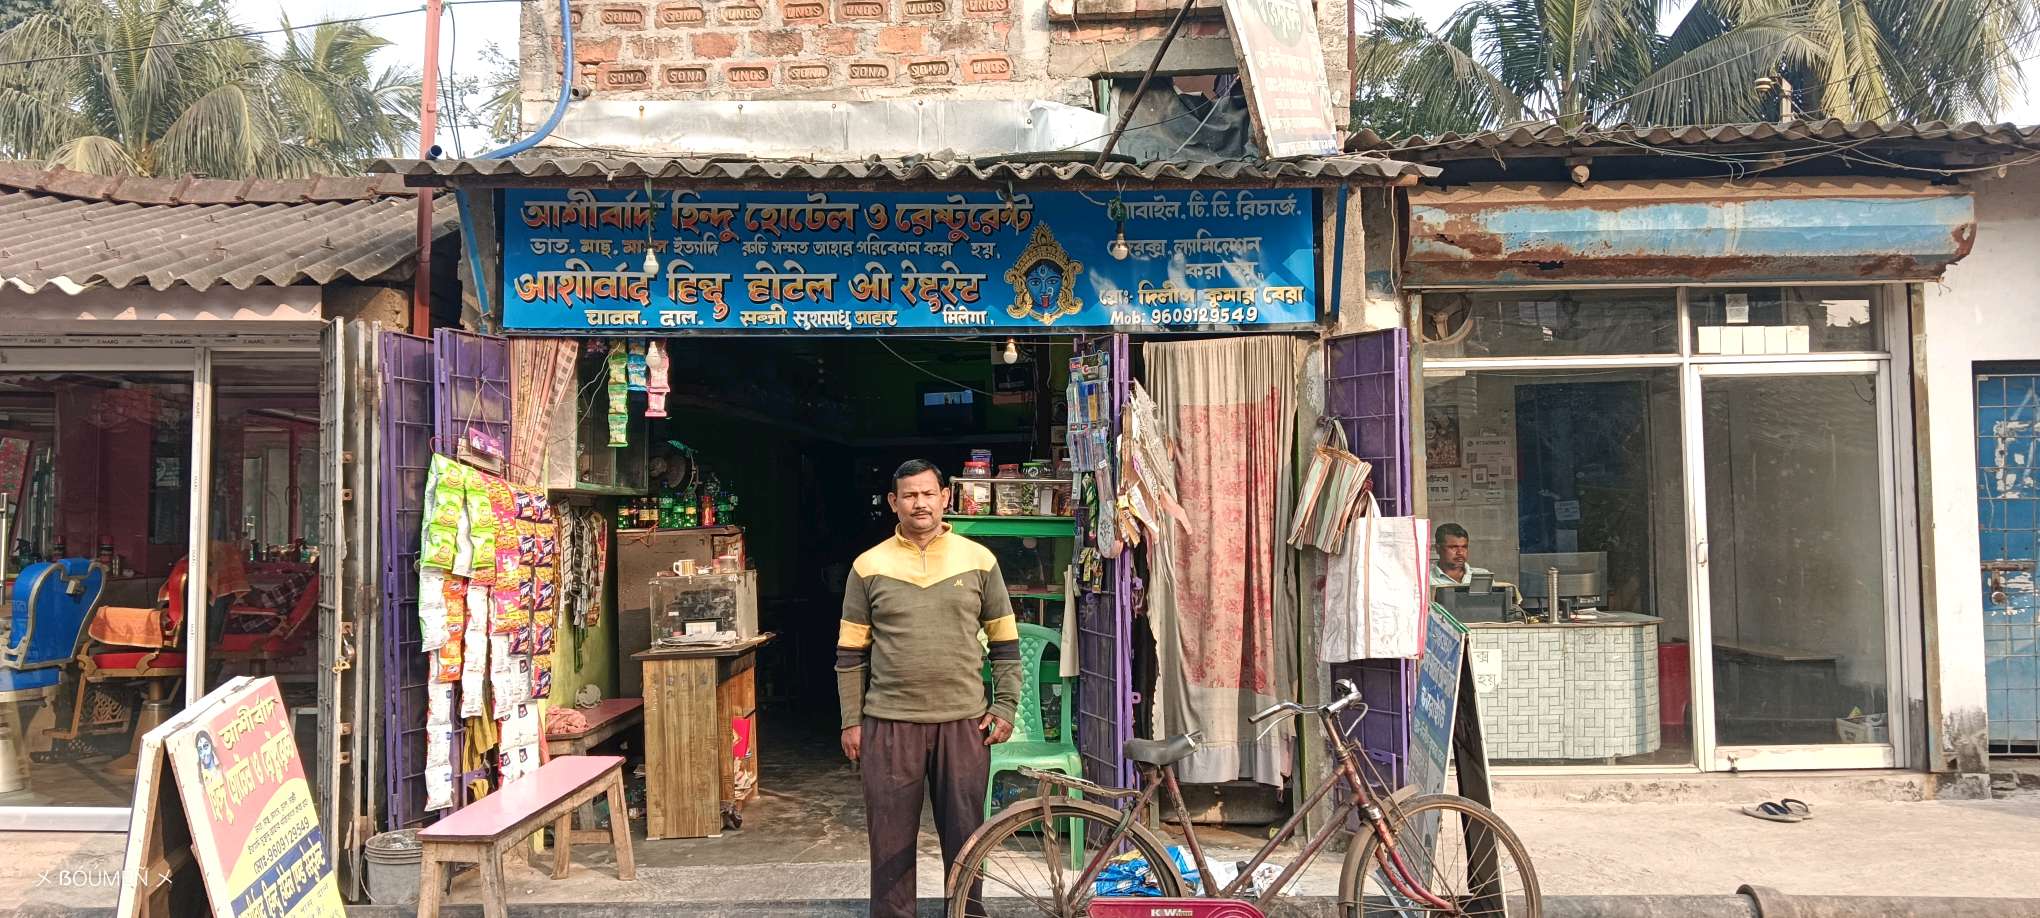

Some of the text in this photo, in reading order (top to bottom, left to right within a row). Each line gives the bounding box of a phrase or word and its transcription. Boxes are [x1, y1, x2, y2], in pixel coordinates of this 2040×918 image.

[520, 189, 664, 231] আশীর্বাদ
[671, 190, 739, 241] হিন্দু
[745, 194, 859, 236] হোটেল
[864, 202, 888, 231] ও
[622, 240, 668, 255] মাস
[673, 232, 720, 256] ইত্যাদি
[812, 241, 854, 257] আহার
[924, 241, 953, 256] করা
[513, 258, 656, 306] आशीर्वाद
[1202, 286, 1257, 309] কুমার
[1263, 286, 1305, 305] বেরা
[855, 310, 898, 327] आहार
[1110, 306, 1258, 325] Mob: 9609129549
[217, 694, 279, 750] আশীর্বাদ
